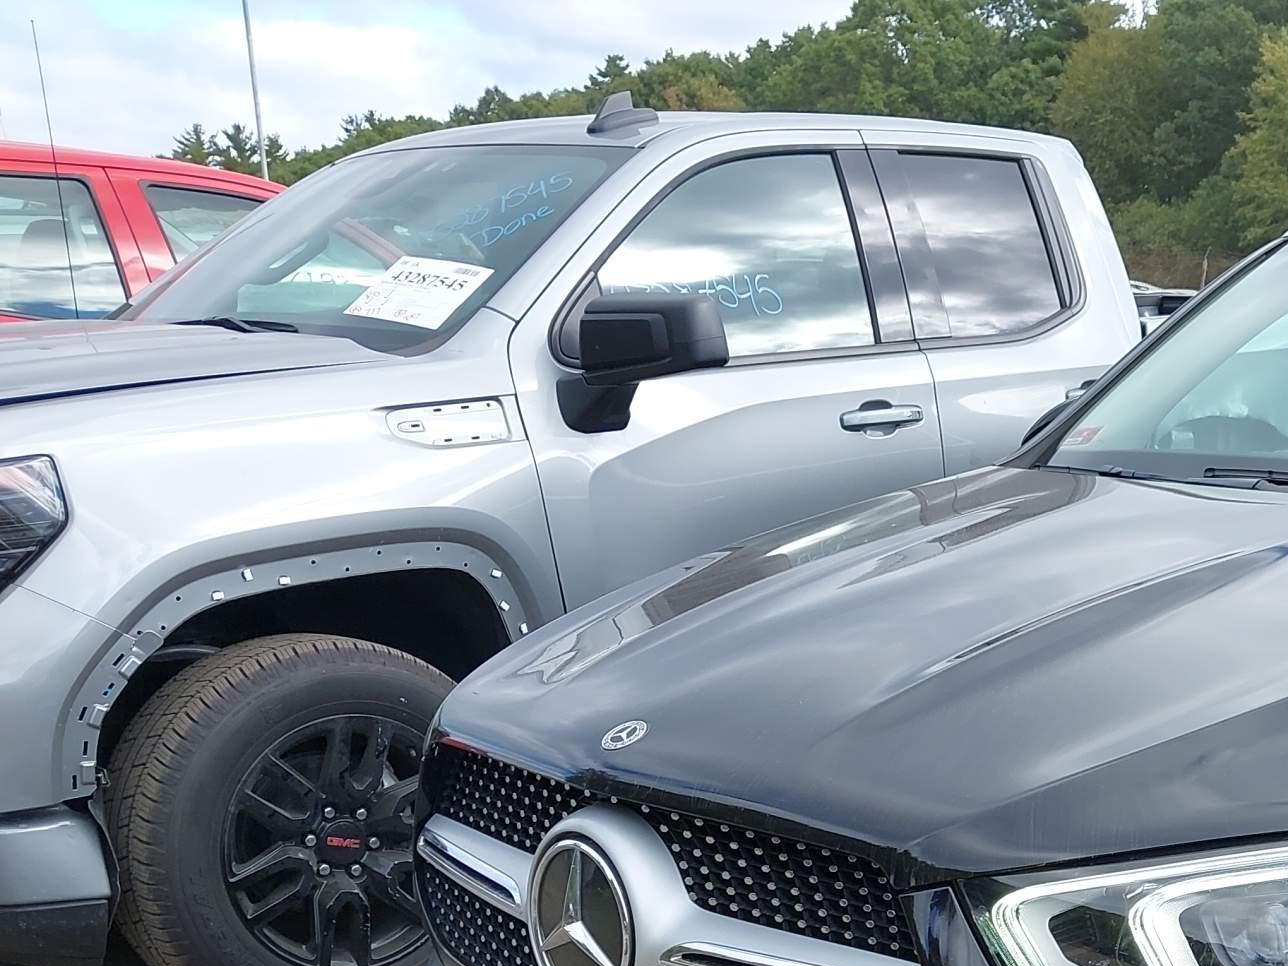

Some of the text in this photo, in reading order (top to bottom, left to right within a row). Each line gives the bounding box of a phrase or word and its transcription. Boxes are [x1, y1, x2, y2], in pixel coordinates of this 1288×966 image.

[470, 204, 556, 248] Done
[391, 269, 471, 292] 43287545
[326, 836, 361, 849] GMC
